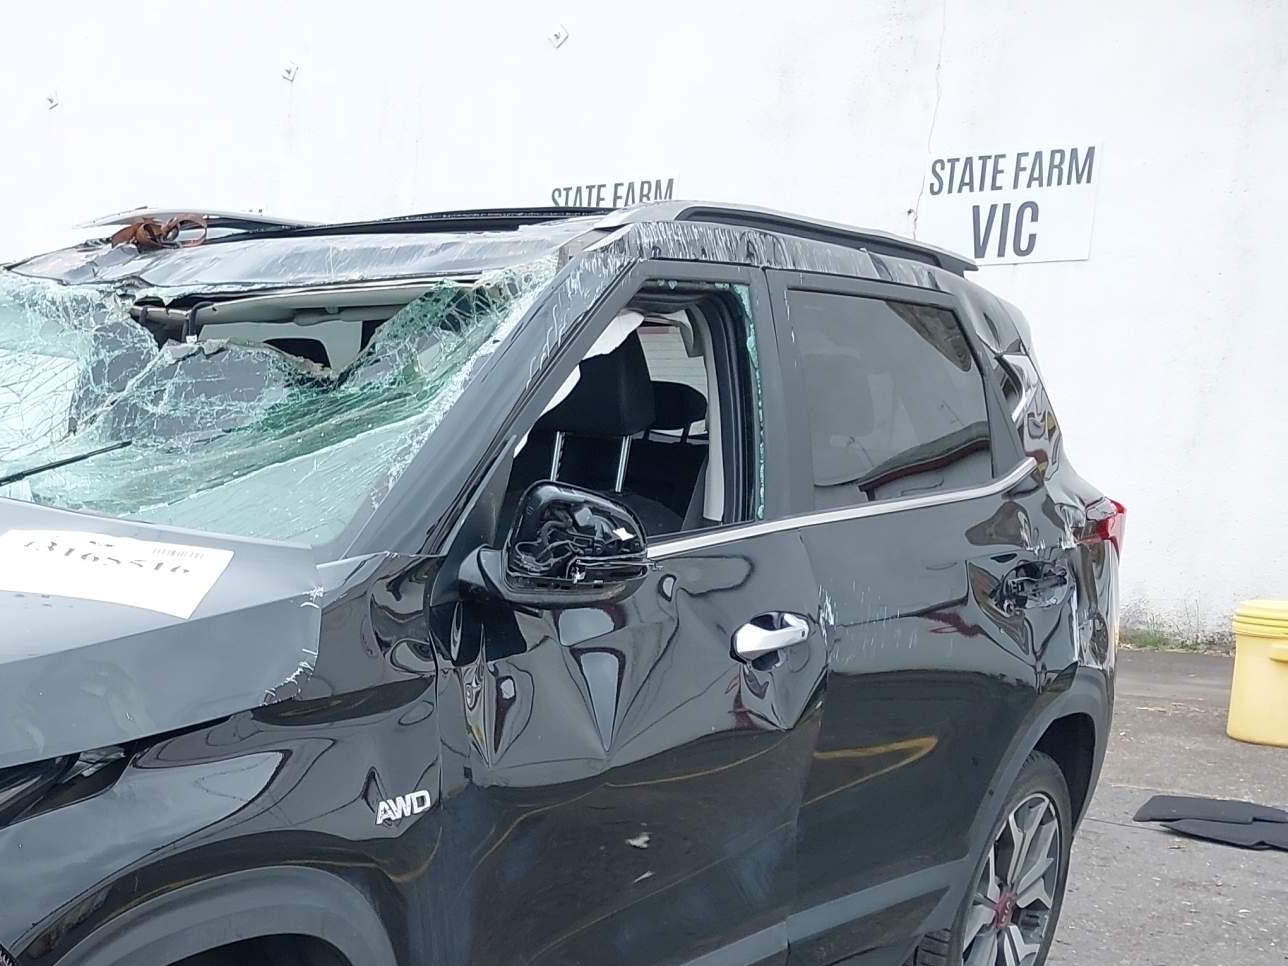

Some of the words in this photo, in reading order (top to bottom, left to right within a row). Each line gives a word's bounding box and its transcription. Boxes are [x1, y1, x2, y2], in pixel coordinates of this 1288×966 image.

[929, 154, 1007, 196] STATE
[1012, 146, 1096, 190] FARM
[551, 183, 606, 208] STATE
[613, 178, 674, 208] FARM
[972, 200, 1039, 259] VIC
[375, 790, 431, 825] AWD
